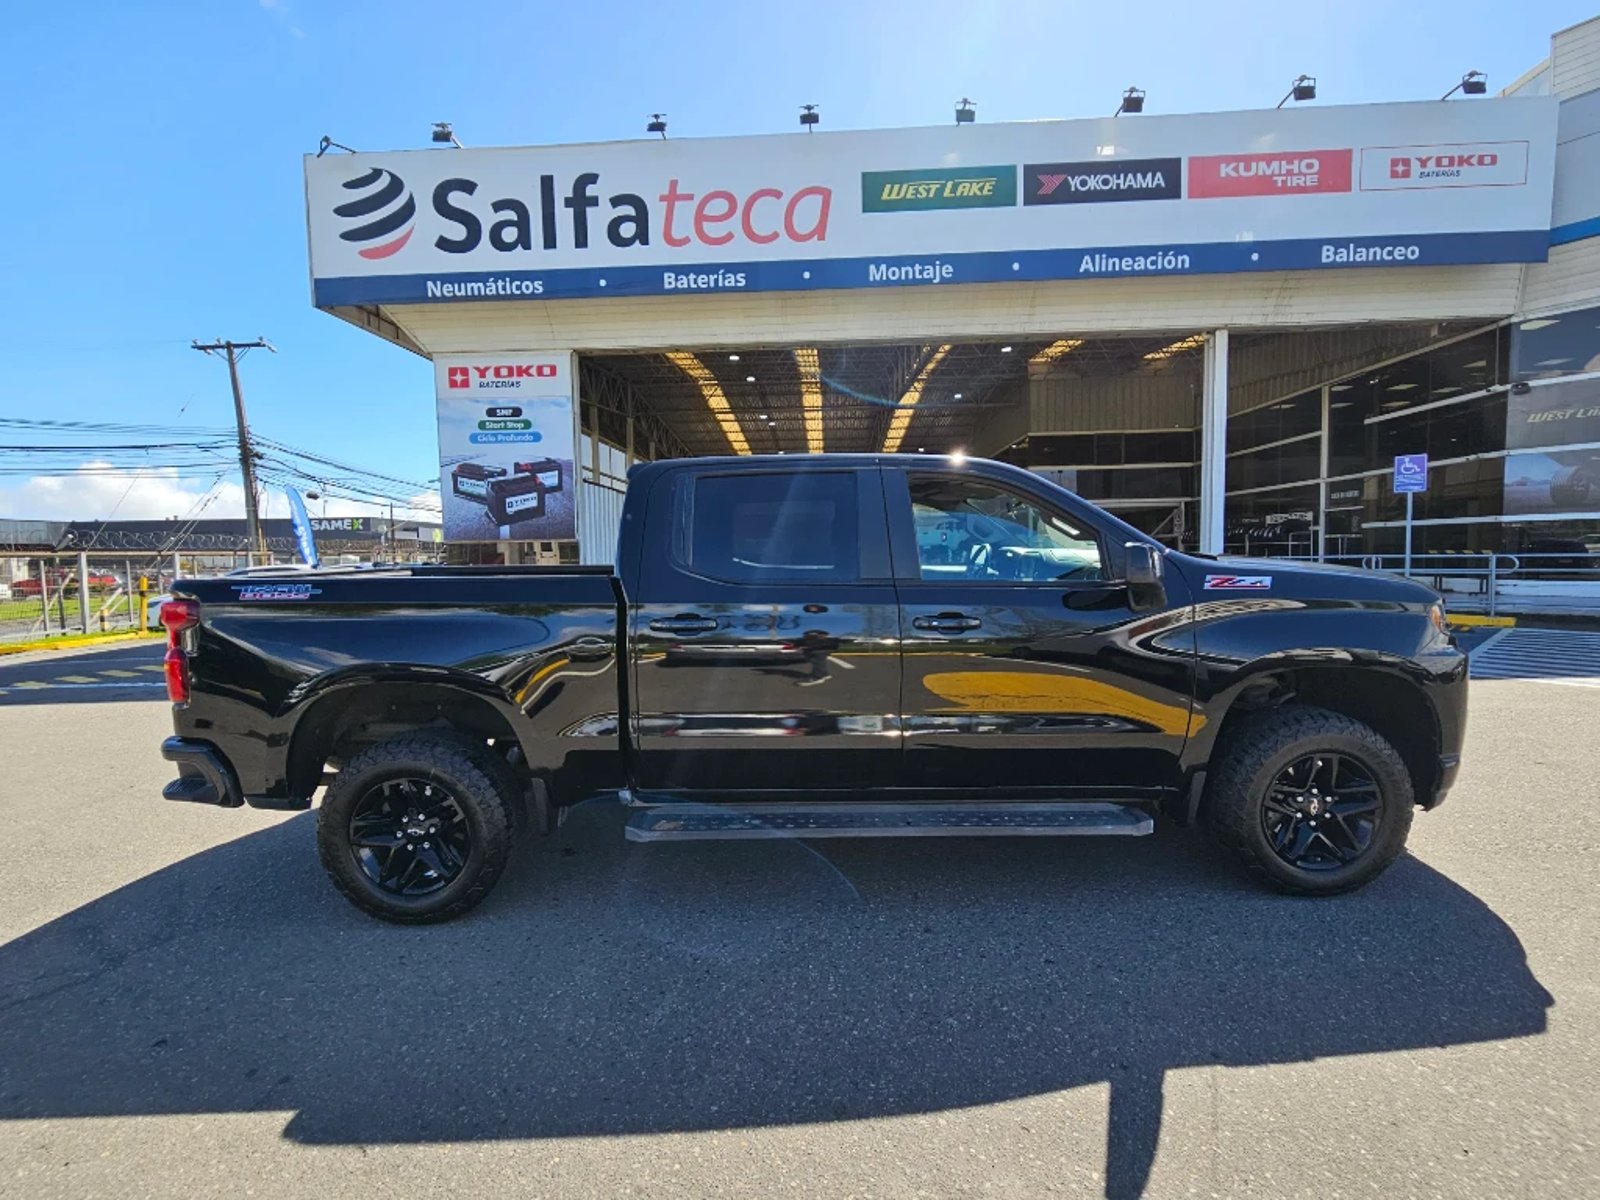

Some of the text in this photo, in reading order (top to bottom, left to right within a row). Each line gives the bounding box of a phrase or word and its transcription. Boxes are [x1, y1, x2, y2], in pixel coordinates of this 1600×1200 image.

[1219, 157, 1320, 177] KUMHO
[1415, 153, 1498, 169] YOKO
[880, 180, 997, 201] WEST LAKE
[1067, 171, 1166, 192] YOKOHAMA
[1272, 174, 1320, 188] TIRE
[432, 172, 833, 254] Salfateca
[426, 243, 1420, 298] Neumáticos Baterías Montaje Alineación Balanceo
[472, 364, 557, 379] YOKO
[311, 518, 364, 531] SAMEX
